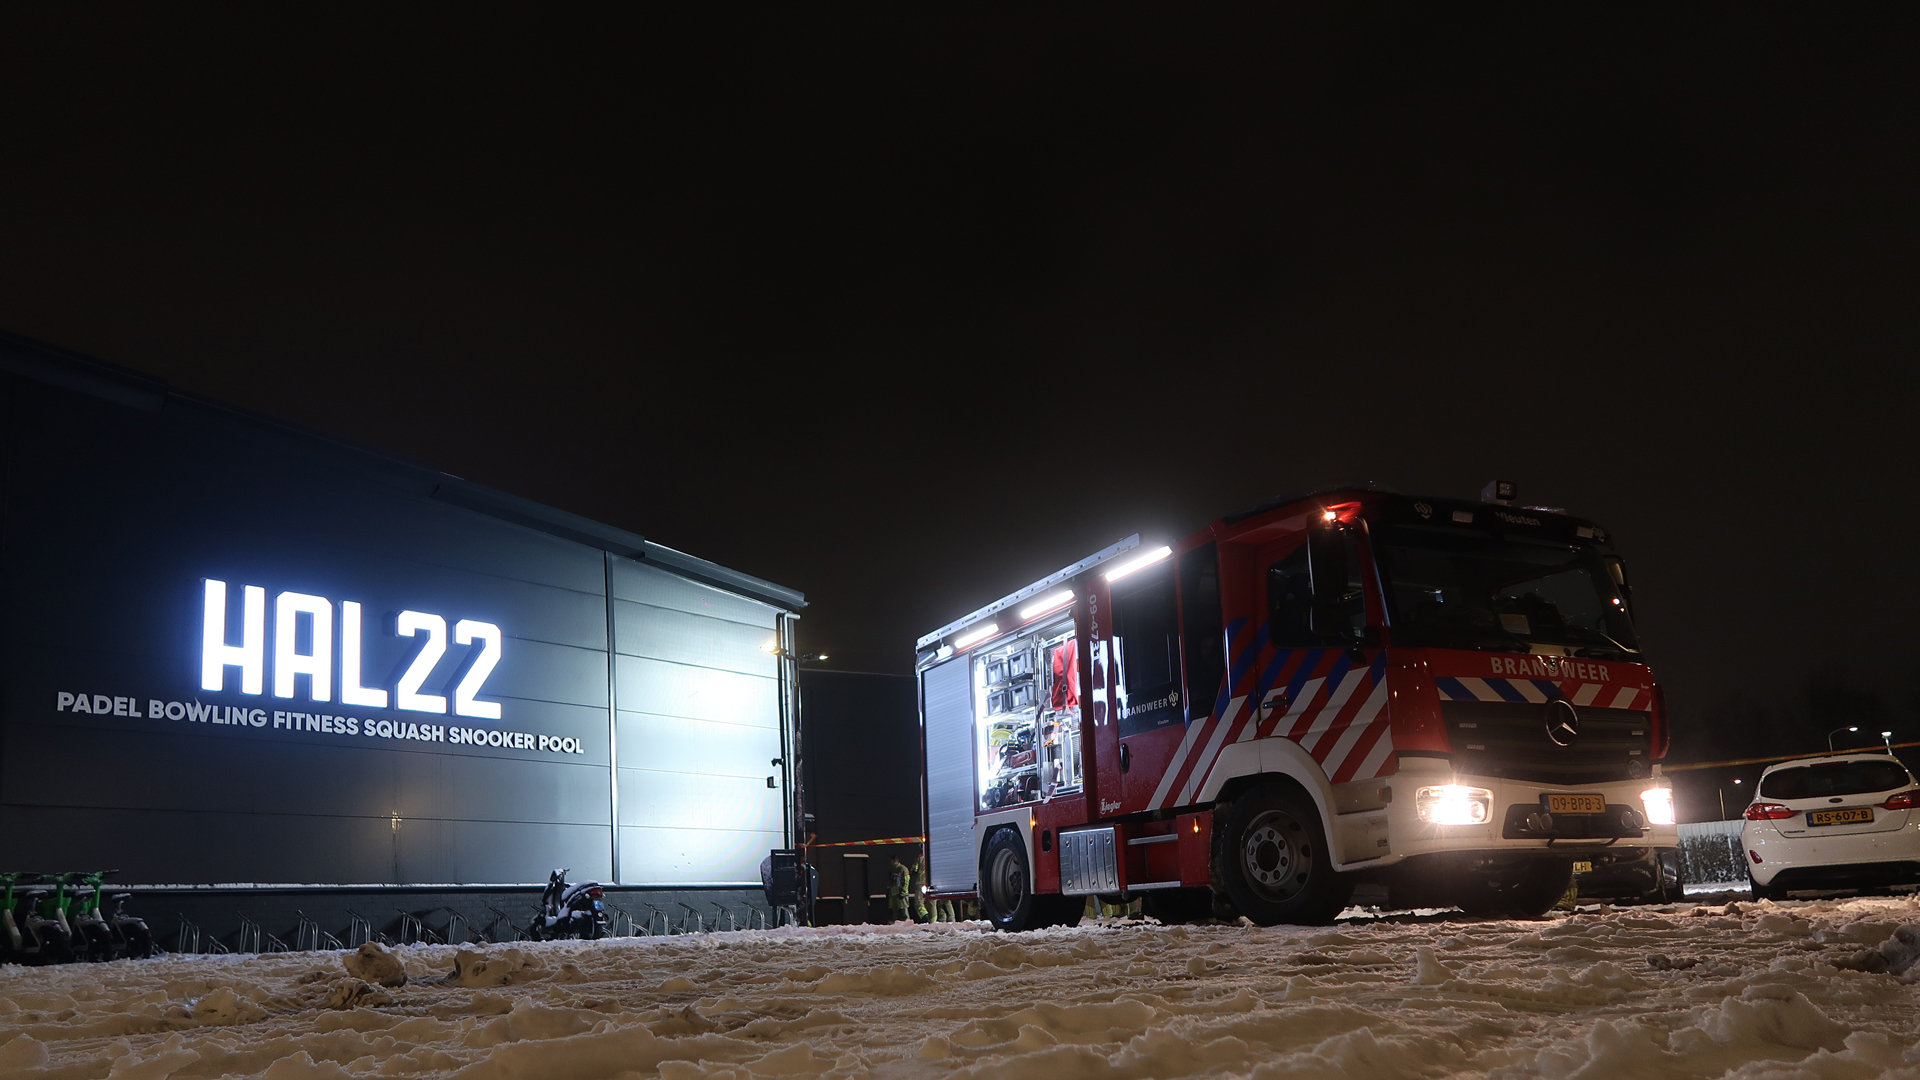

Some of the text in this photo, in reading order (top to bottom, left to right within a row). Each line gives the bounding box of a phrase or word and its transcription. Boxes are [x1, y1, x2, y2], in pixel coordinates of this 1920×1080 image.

[200, 577, 501, 719] HAL22
[1490, 656, 1610, 682] BRANDWEER
[57, 691, 584, 754] PADEL BOWLING FITNESS SQUASH SNOOKER POOL
[1552, 797, 1602, 811] 09-BPB-3
[1816, 810, 1869, 823] RS-607-B
